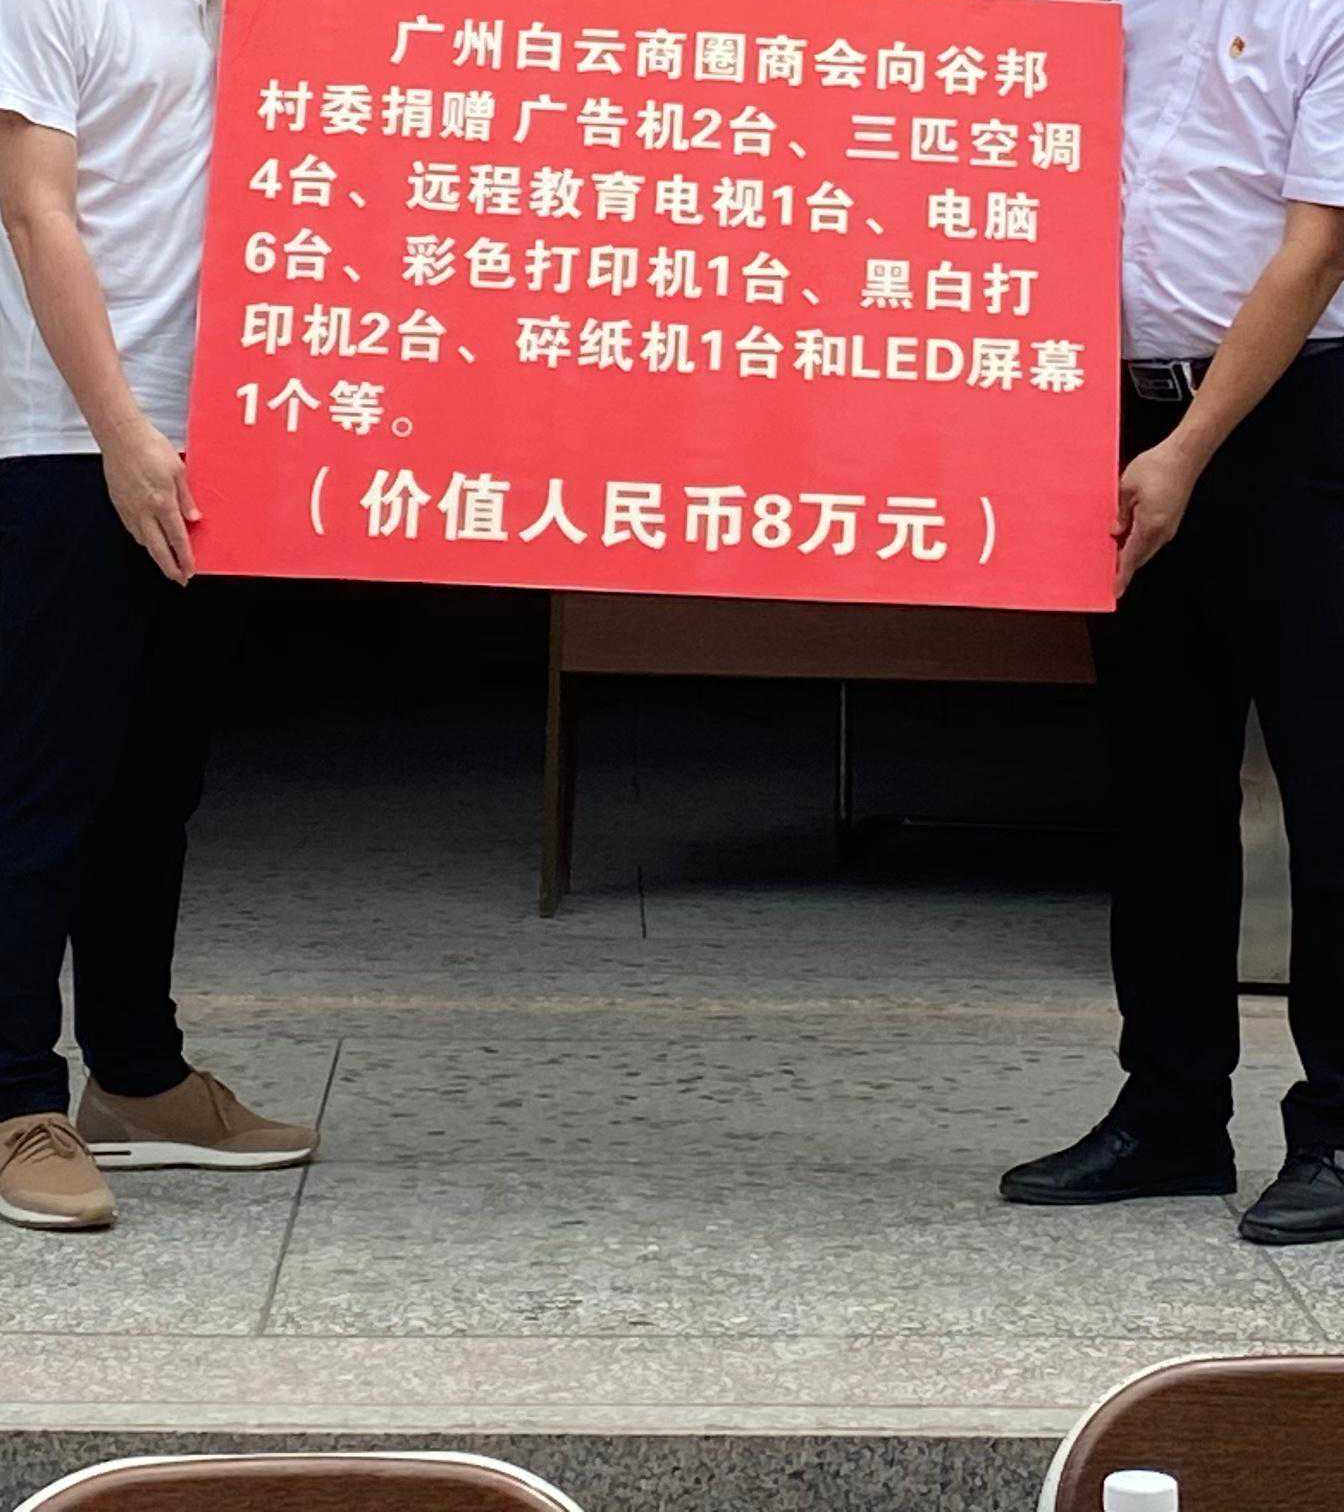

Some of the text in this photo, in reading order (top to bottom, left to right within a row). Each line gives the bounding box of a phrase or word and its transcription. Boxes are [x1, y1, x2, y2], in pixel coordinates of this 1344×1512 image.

[390, 15, 1049, 99] 广州白云商圈商会向谷邦
[235, 378, 413, 439] 1个等。
